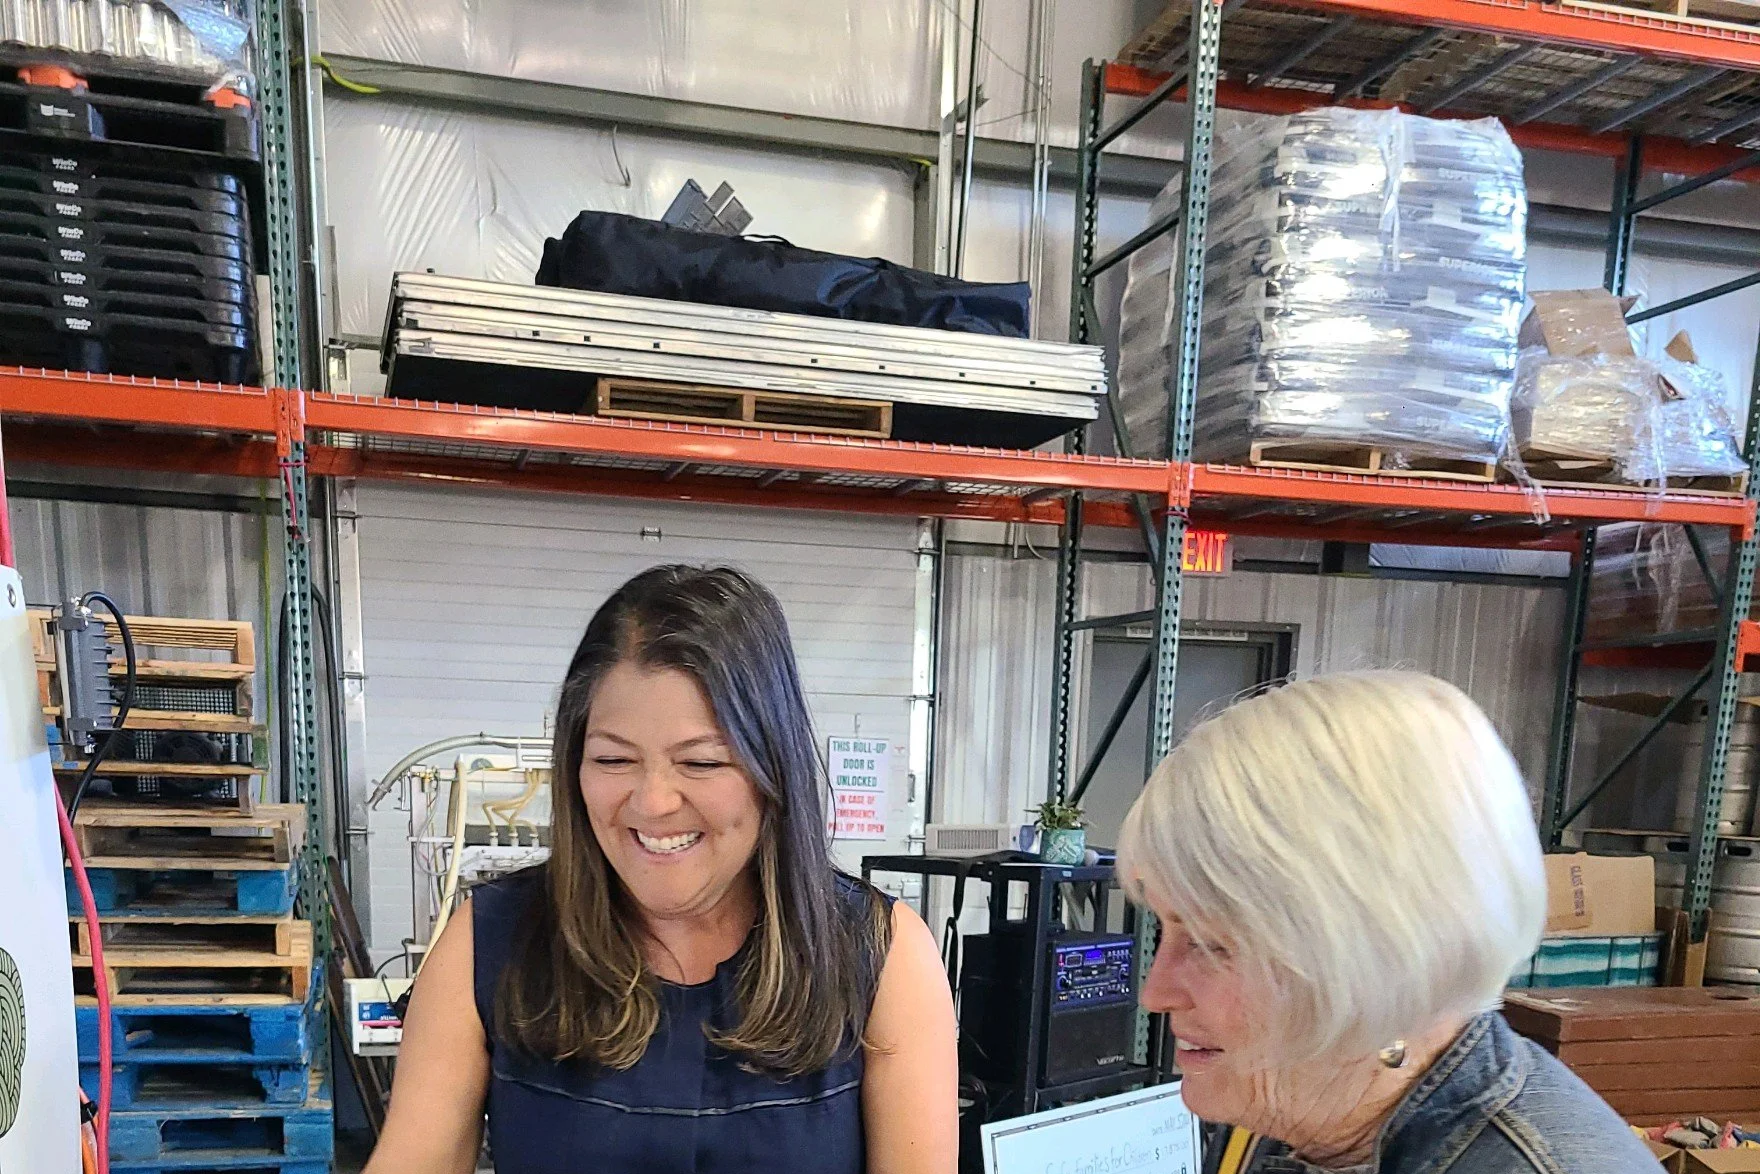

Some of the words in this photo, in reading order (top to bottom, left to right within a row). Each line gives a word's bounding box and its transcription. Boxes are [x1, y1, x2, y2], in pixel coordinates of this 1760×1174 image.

[1182, 531, 1228, 573] EXIT
[833, 741, 850, 752] THIS
[853, 742, 887, 754] ROLL-UP
[843, 759, 864, 770] DOOR
[867, 760, 875, 770] IS
[837, 775, 878, 787] UNLOCKED
[849, 795, 864, 804] CASE
[867, 796, 875, 804] OF
[846, 823, 855, 832] UP
[857, 823, 865, 832] TO
[867, 823, 885, 833] OPEN
[1155, 1147, 1161, 1161] $
